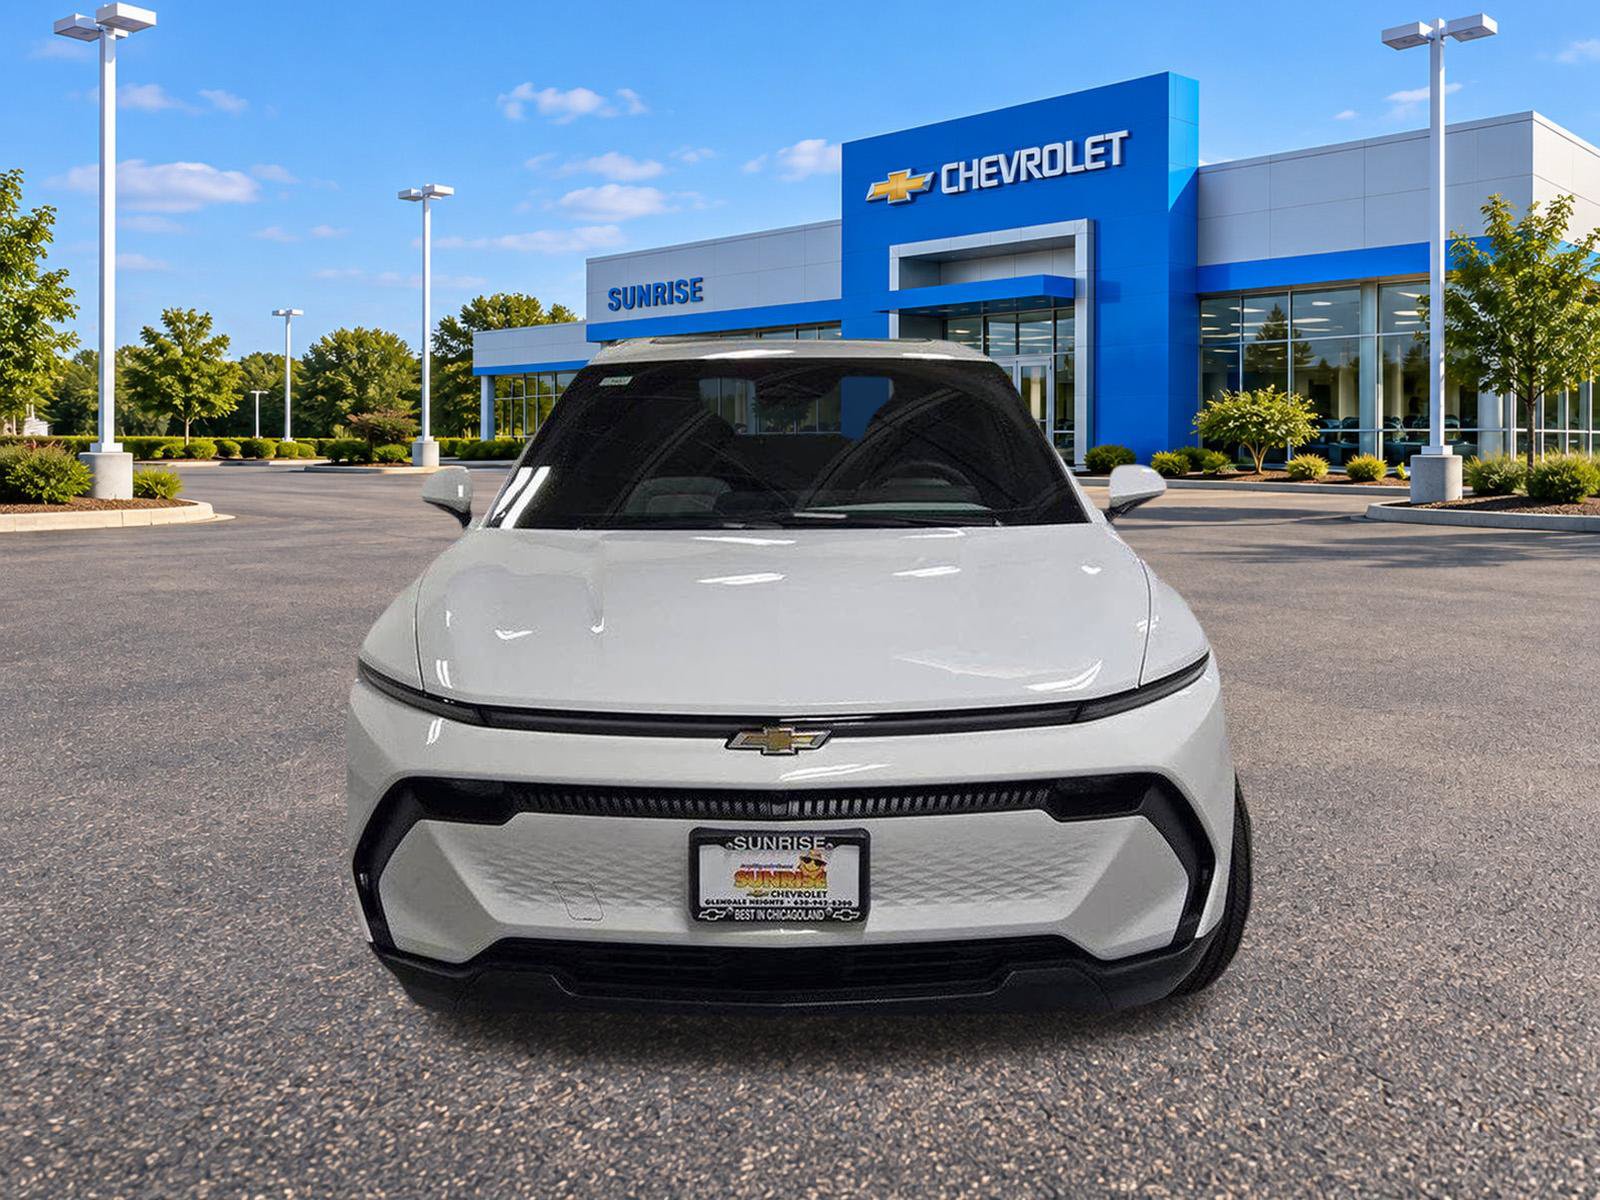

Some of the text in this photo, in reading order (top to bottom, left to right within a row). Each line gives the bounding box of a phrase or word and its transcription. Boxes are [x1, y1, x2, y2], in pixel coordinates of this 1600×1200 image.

[940, 130, 1129, 195] CHEVROLET
[608, 277, 704, 312] SUNRISE
[734, 837, 826, 850] SUNRISE
[734, 870, 827, 888] SUNRISE
[771, 890, 828, 898] CHEVROLET
[734, 909, 825, 921] BEST IN CHICAGOLAND
